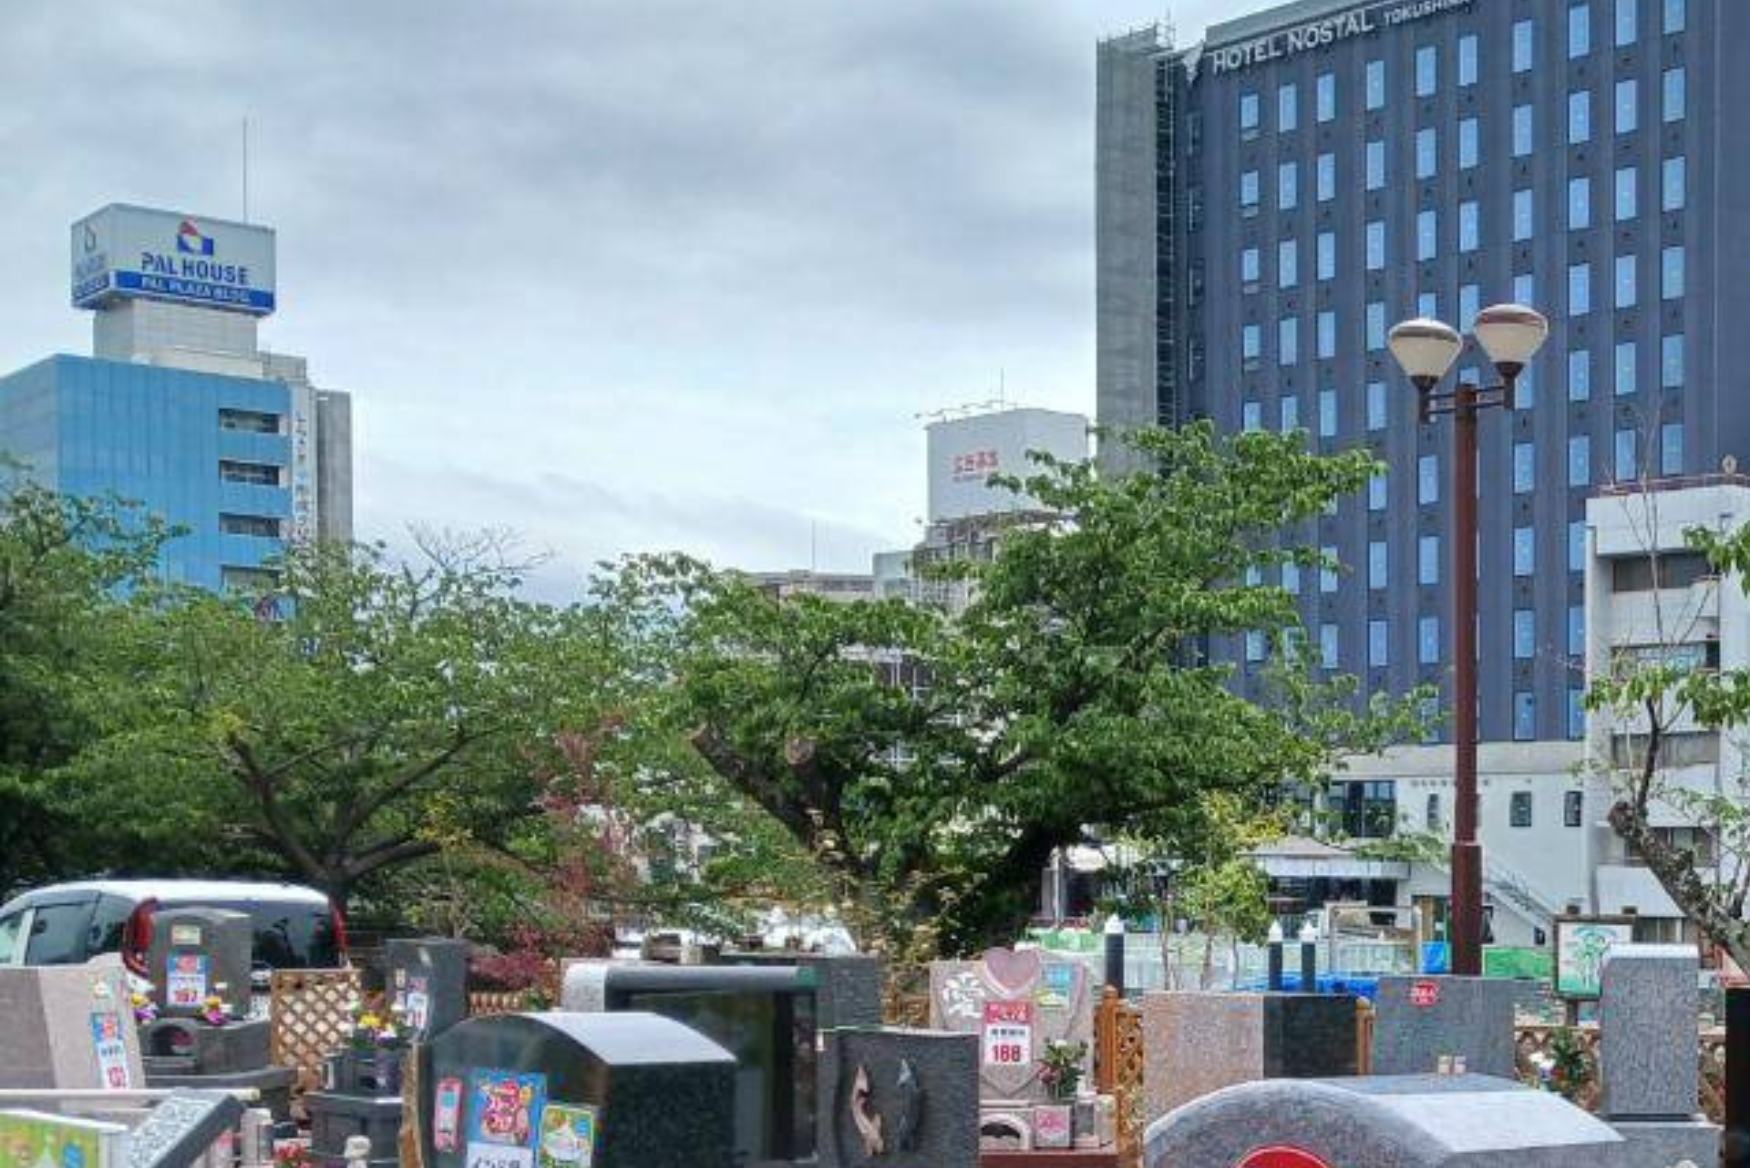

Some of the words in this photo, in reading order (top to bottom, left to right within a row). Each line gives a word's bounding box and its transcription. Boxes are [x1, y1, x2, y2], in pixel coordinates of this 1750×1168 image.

[1213, 37, 1283, 75] HOTEL
[1287, 10, 1375, 54] NOSTAL
[1383, 0, 1471, 27] TOKUSHI
[141, 251, 179, 276] PAL
[182, 258, 250, 286] HOUSE
